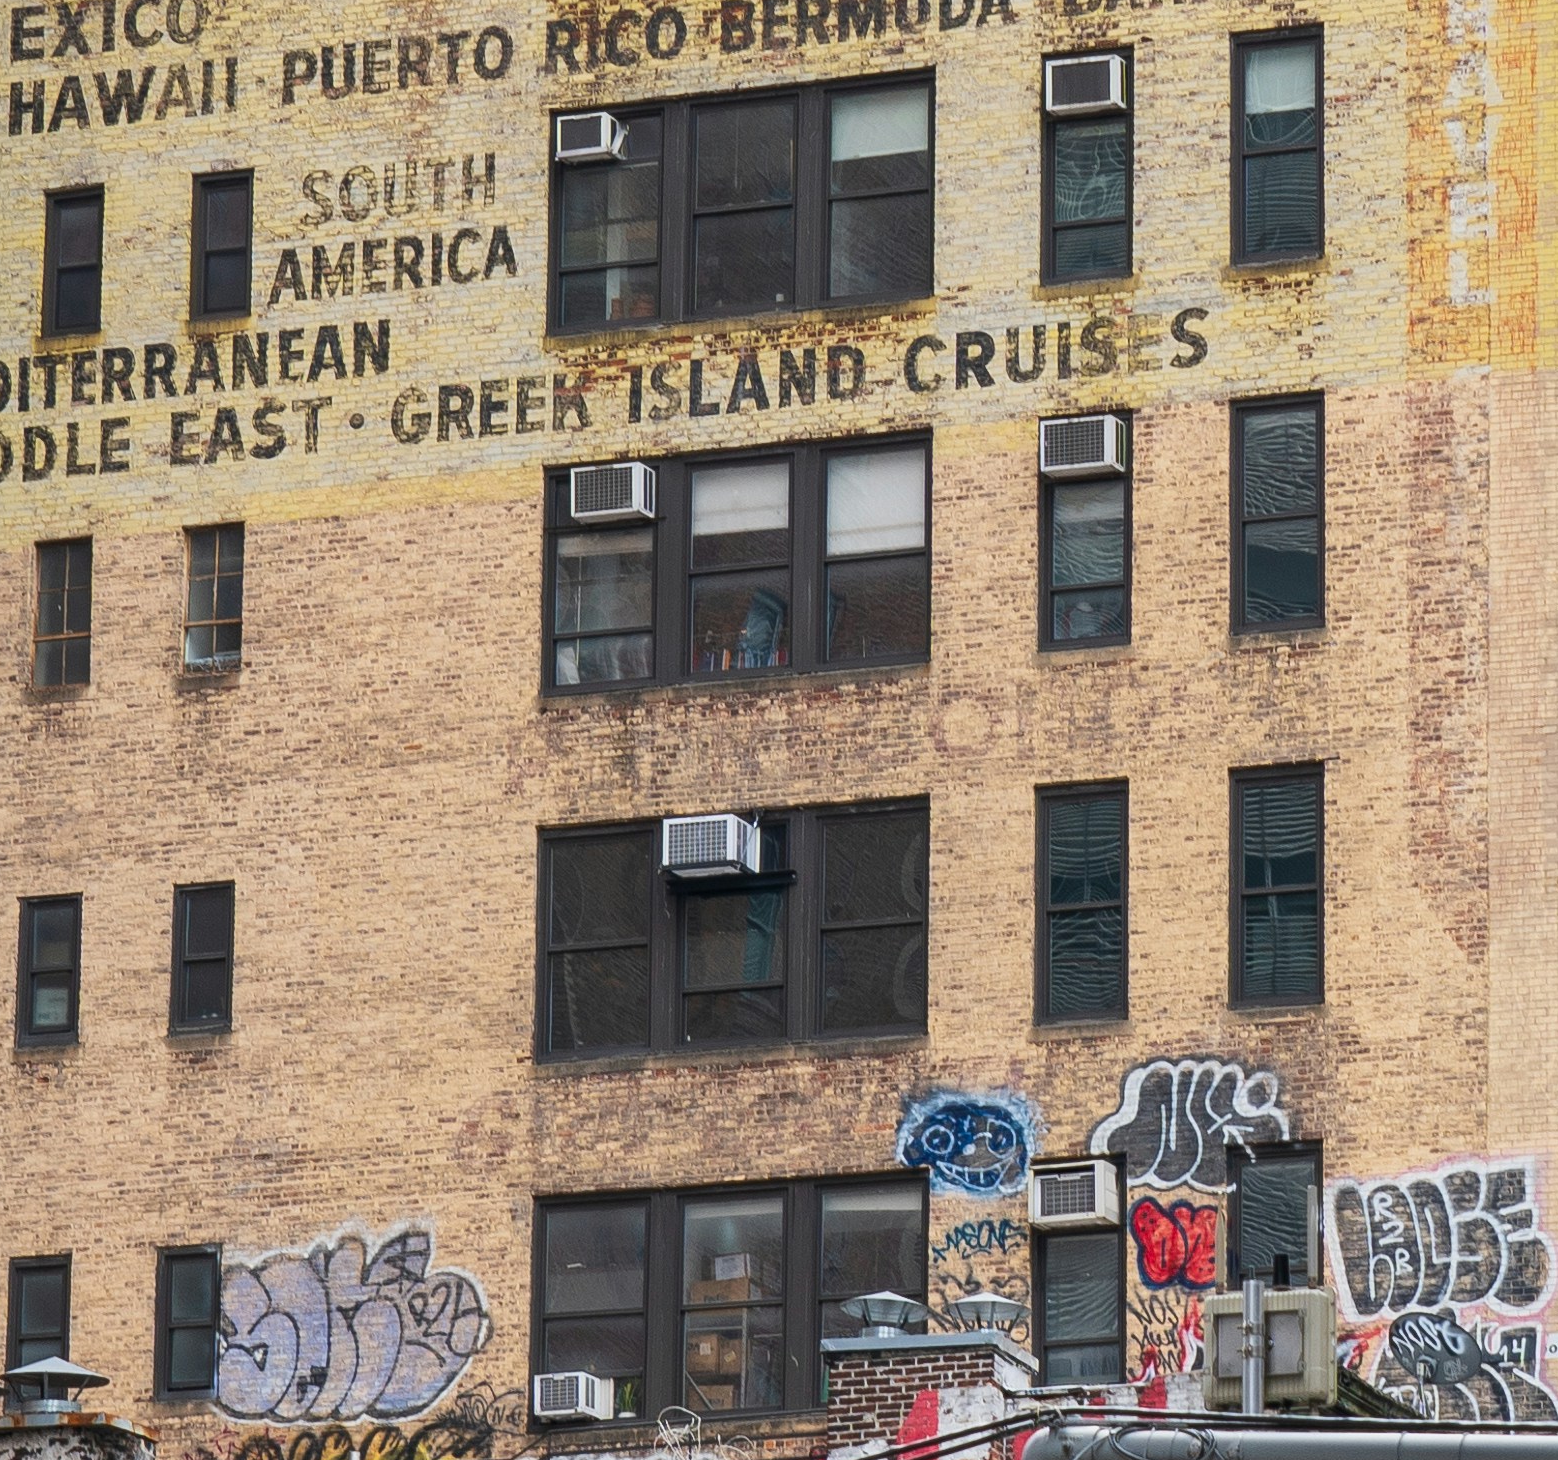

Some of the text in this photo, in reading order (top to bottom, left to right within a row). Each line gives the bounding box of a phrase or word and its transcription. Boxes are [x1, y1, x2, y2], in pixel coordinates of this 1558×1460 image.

[8, 57, 239, 137] HAWAII
[281, 26, 515, 106] PUERTO
[543, 6, 687, 75] RICO
[301, 152, 496, 227] SOUTH
[269, 224, 519, 306] AMERICA
[170, 395, 333, 467] EAST
[391, 364, 589, 449] GREEK
[630, 341, 866, 424] ISLAND
[903, 307, 1211, 394] CRUISES
